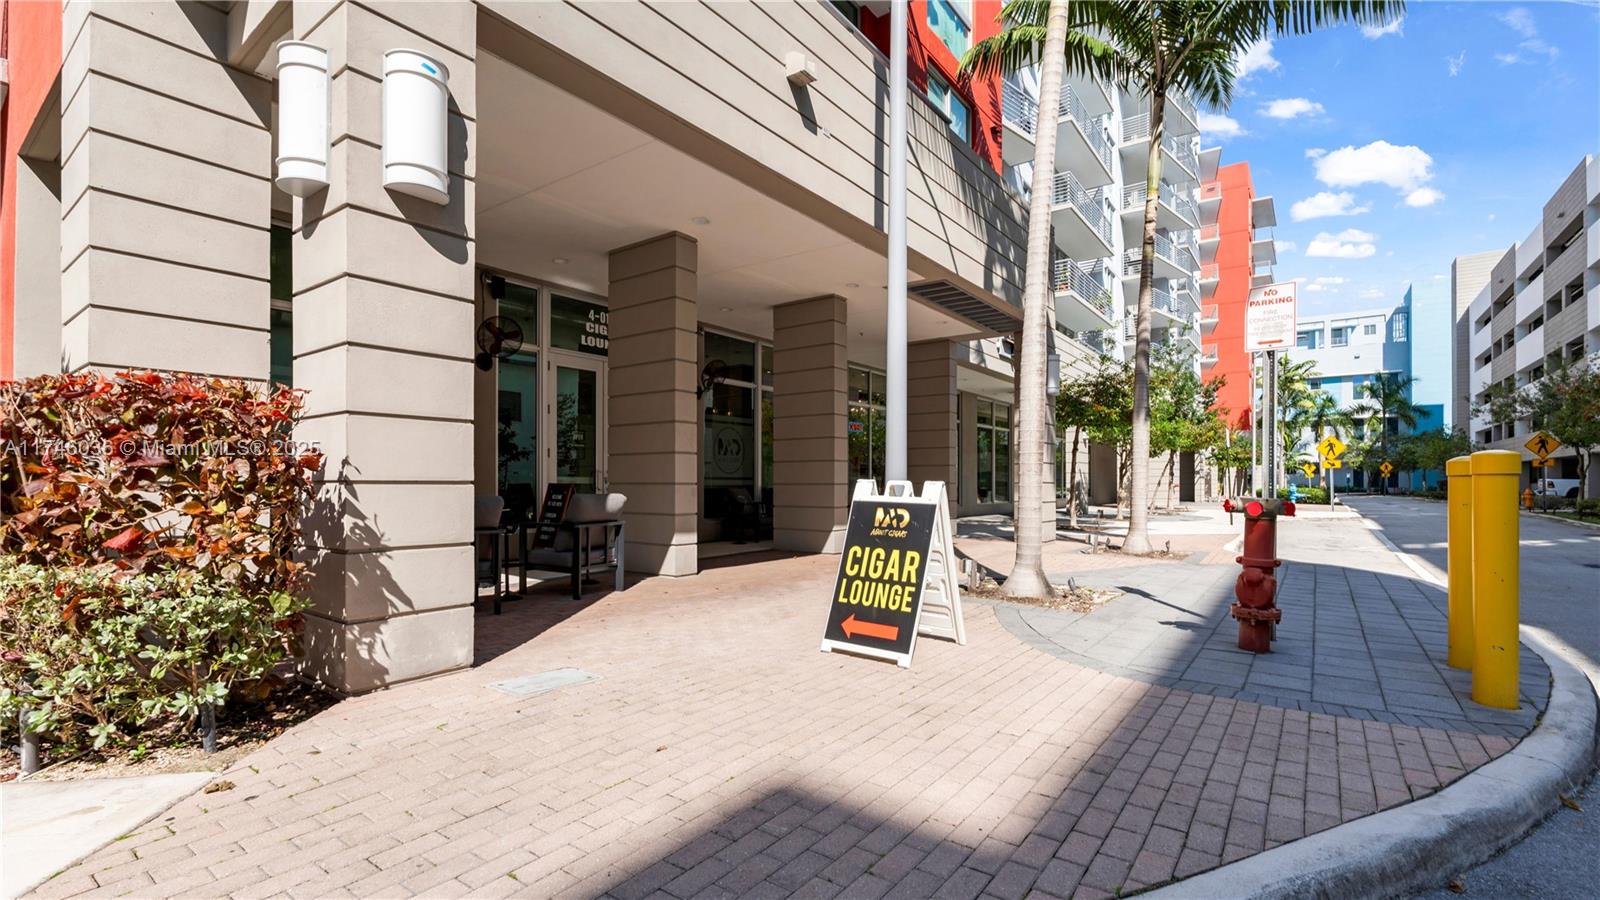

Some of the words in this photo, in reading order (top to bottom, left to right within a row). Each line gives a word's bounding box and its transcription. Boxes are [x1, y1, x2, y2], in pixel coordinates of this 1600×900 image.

[1249, 296, 1293, 307] PARKING
[1264, 289, 1278, 297] NO
[845, 545, 920, 584] CIGAR
[838, 578, 916, 613] LOUNGE
